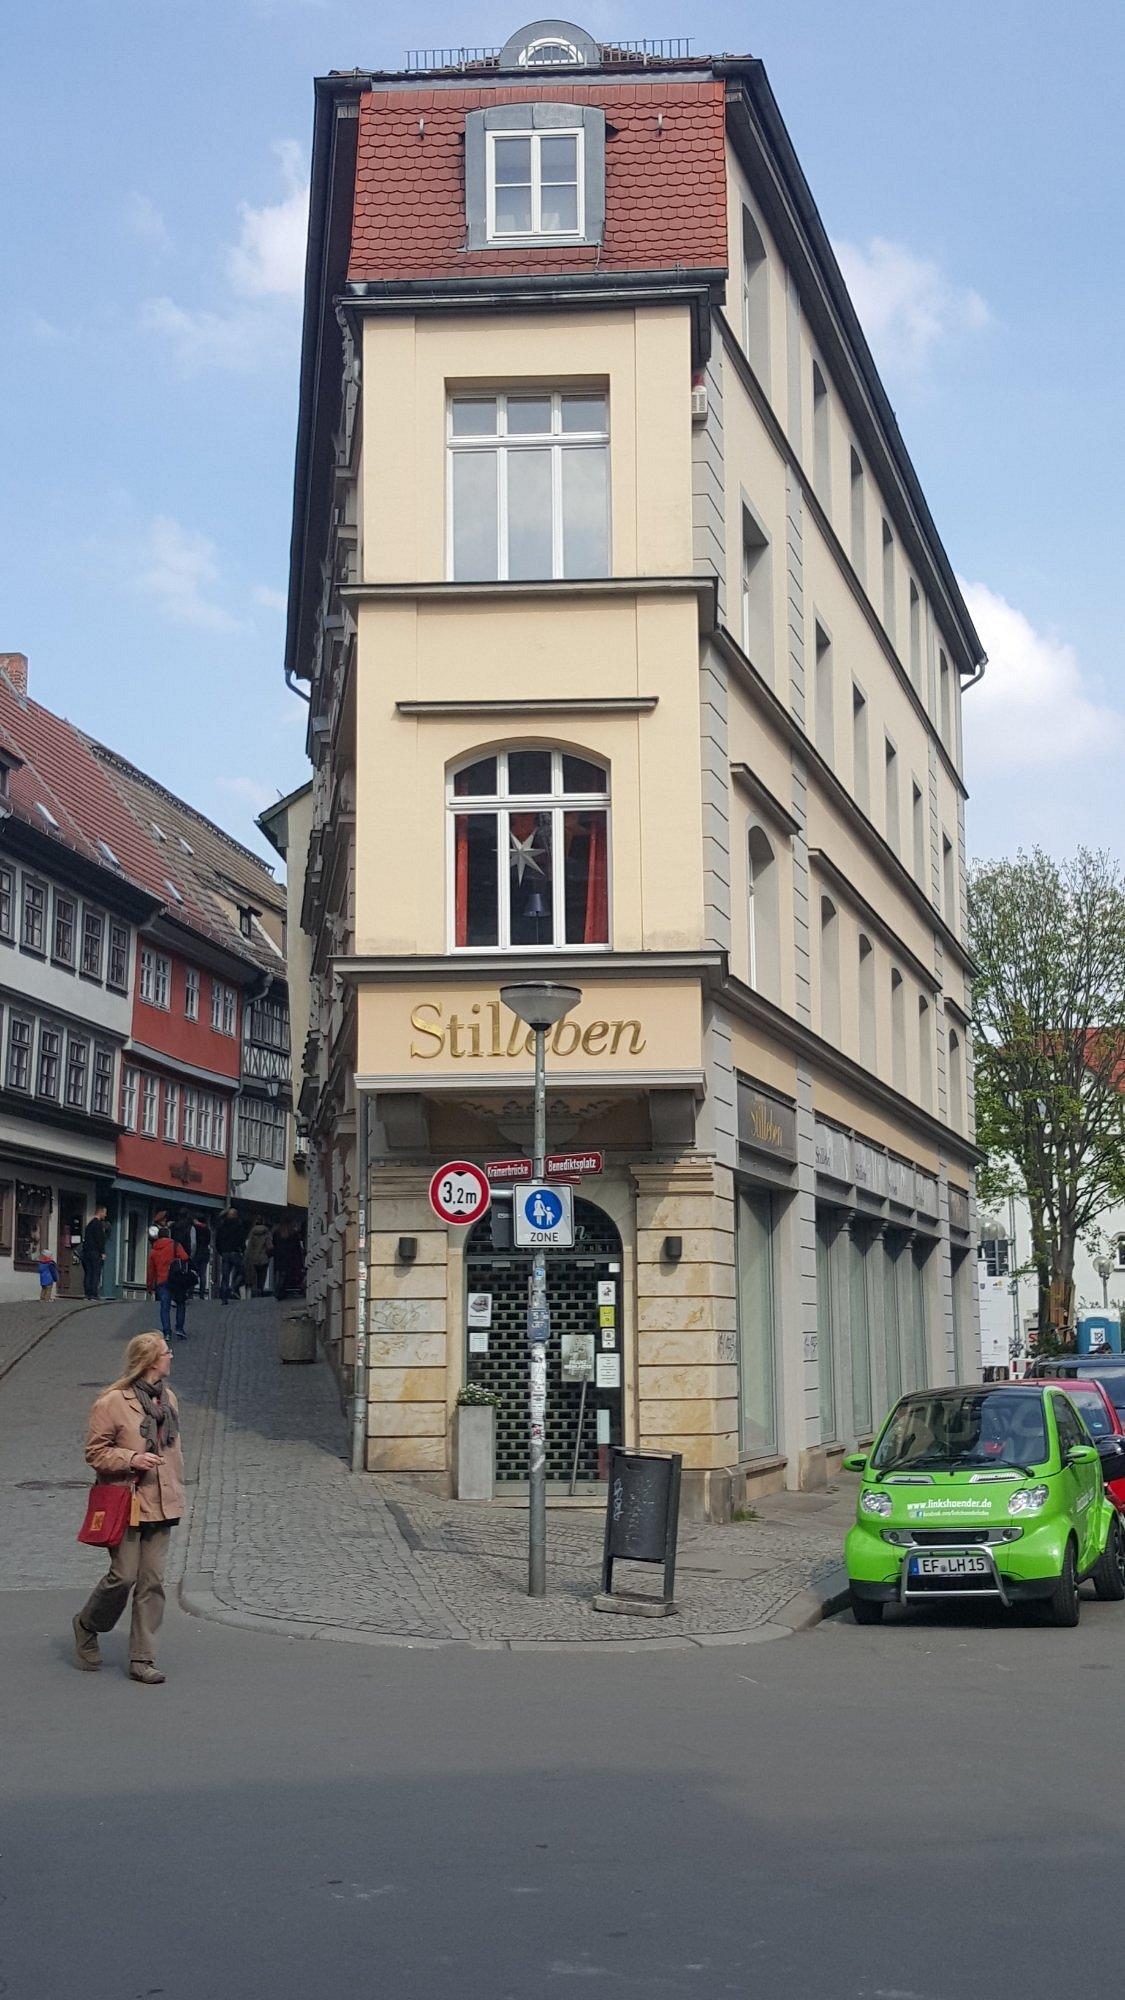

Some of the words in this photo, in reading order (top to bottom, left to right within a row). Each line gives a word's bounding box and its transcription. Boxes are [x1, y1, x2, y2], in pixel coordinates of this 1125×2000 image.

[487, 1162, 529, 1178] Krämerbrücke
[548, 1157, 597, 1173] Benediktsplatz
[530, 1232, 559, 1242] ZONE
[922, 1559, 939, 1573] EF
